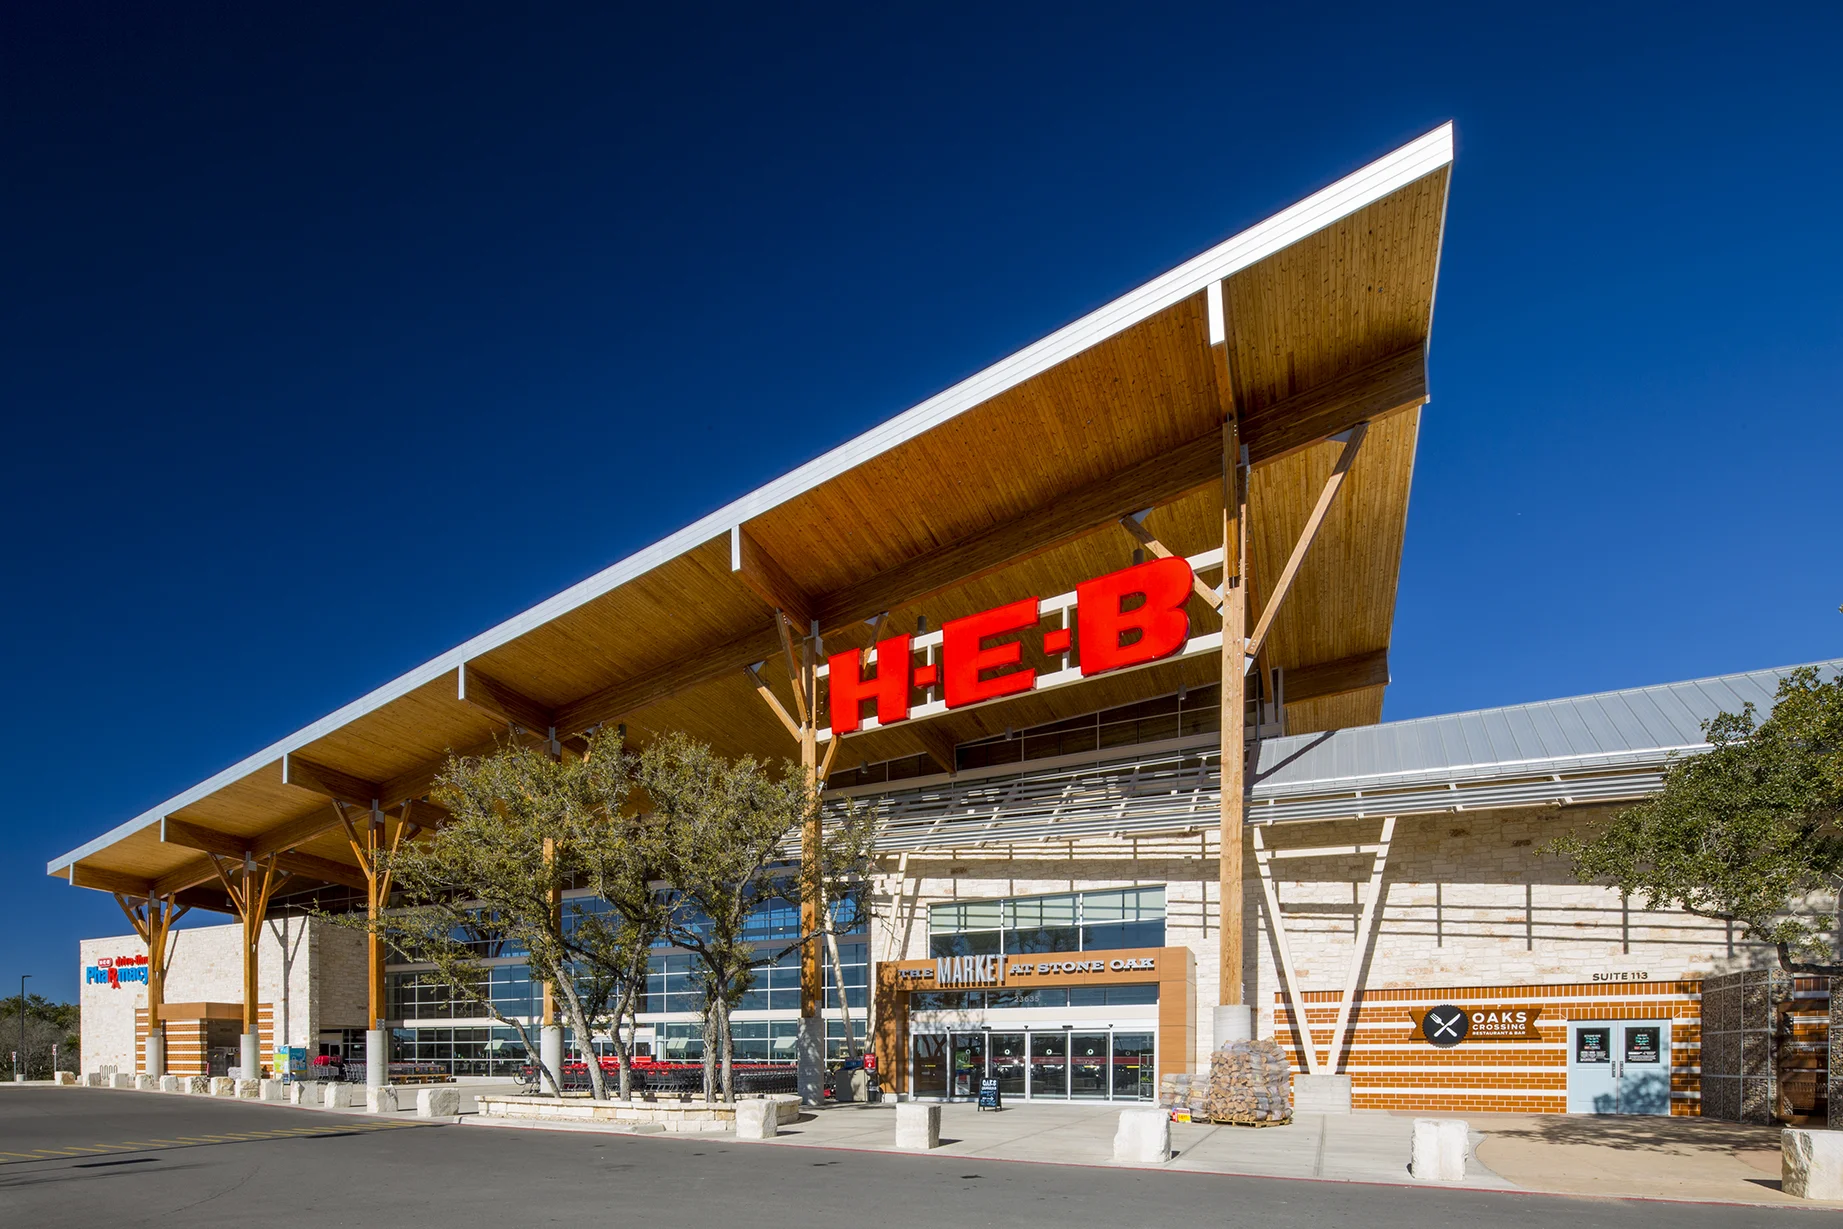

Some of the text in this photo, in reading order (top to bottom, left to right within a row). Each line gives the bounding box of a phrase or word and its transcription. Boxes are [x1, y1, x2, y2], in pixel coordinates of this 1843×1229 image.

[828, 556, 1195, 735] H-E-B
[900, 954, 1155, 986] THE MARKET AT STONE OAK
[1592, 972, 1648, 981] SUITE 113
[1014, 995, 1040, 1003] 23635
[1472, 1011, 1527, 1024] OAKS
[1472, 1023, 1526, 1031] CROSSING
